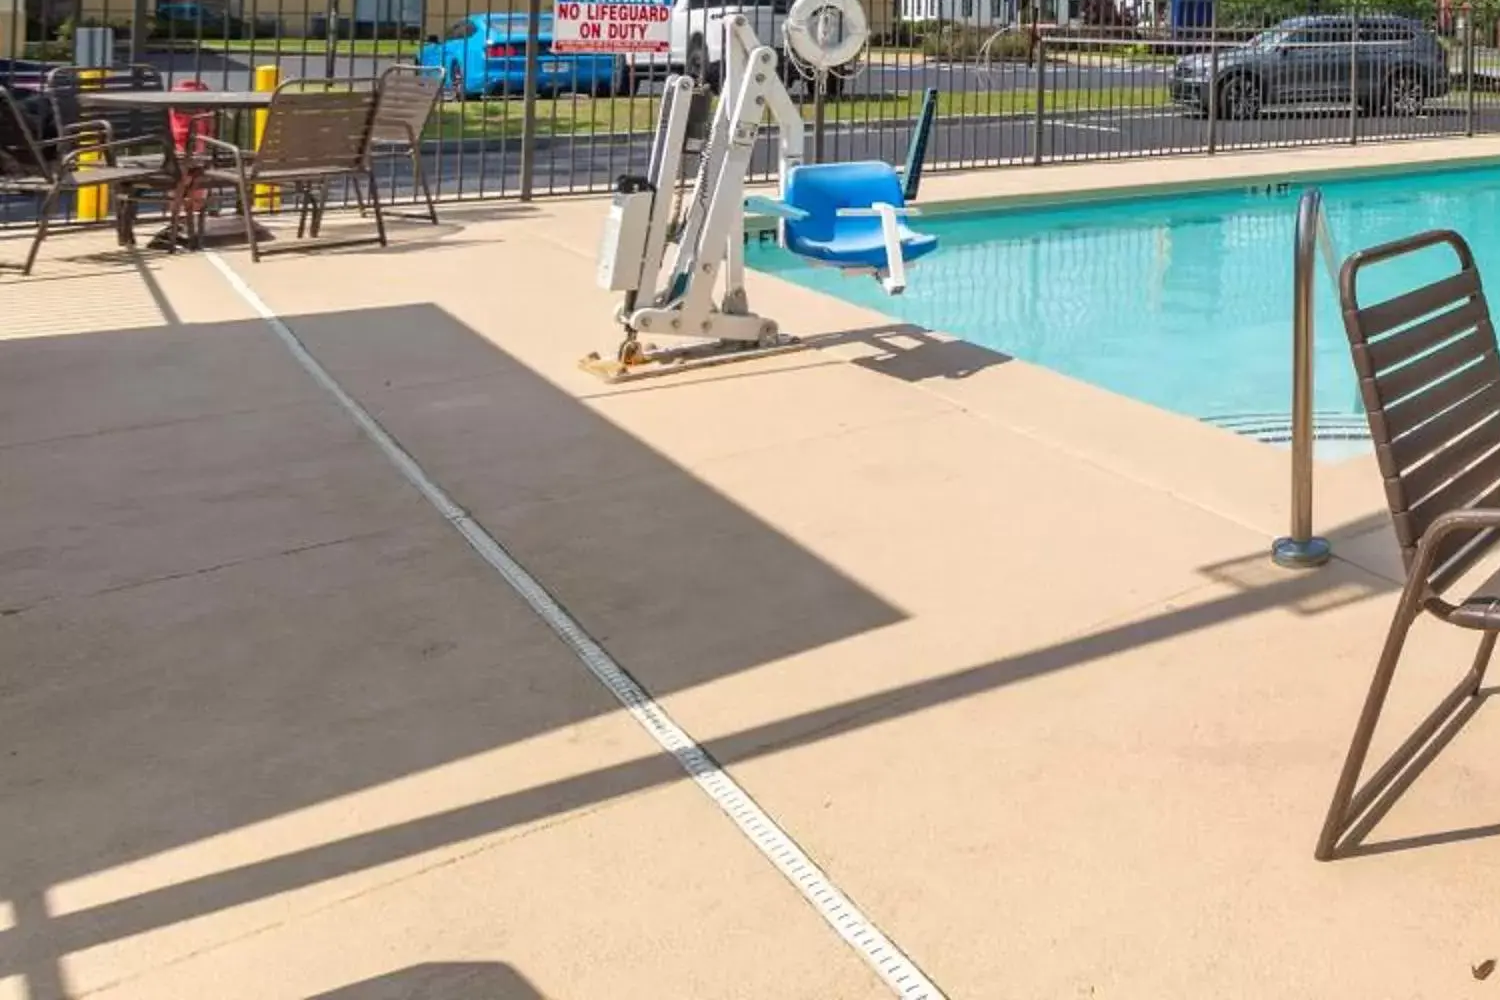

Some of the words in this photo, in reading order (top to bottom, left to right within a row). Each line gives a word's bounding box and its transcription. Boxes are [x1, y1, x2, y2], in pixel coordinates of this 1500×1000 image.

[558, 4, 580, 19] NO
[588, 5, 669, 21] LIFEGUARD
[580, 23, 601, 38] ON
[608, 23, 648, 39] DUTY
